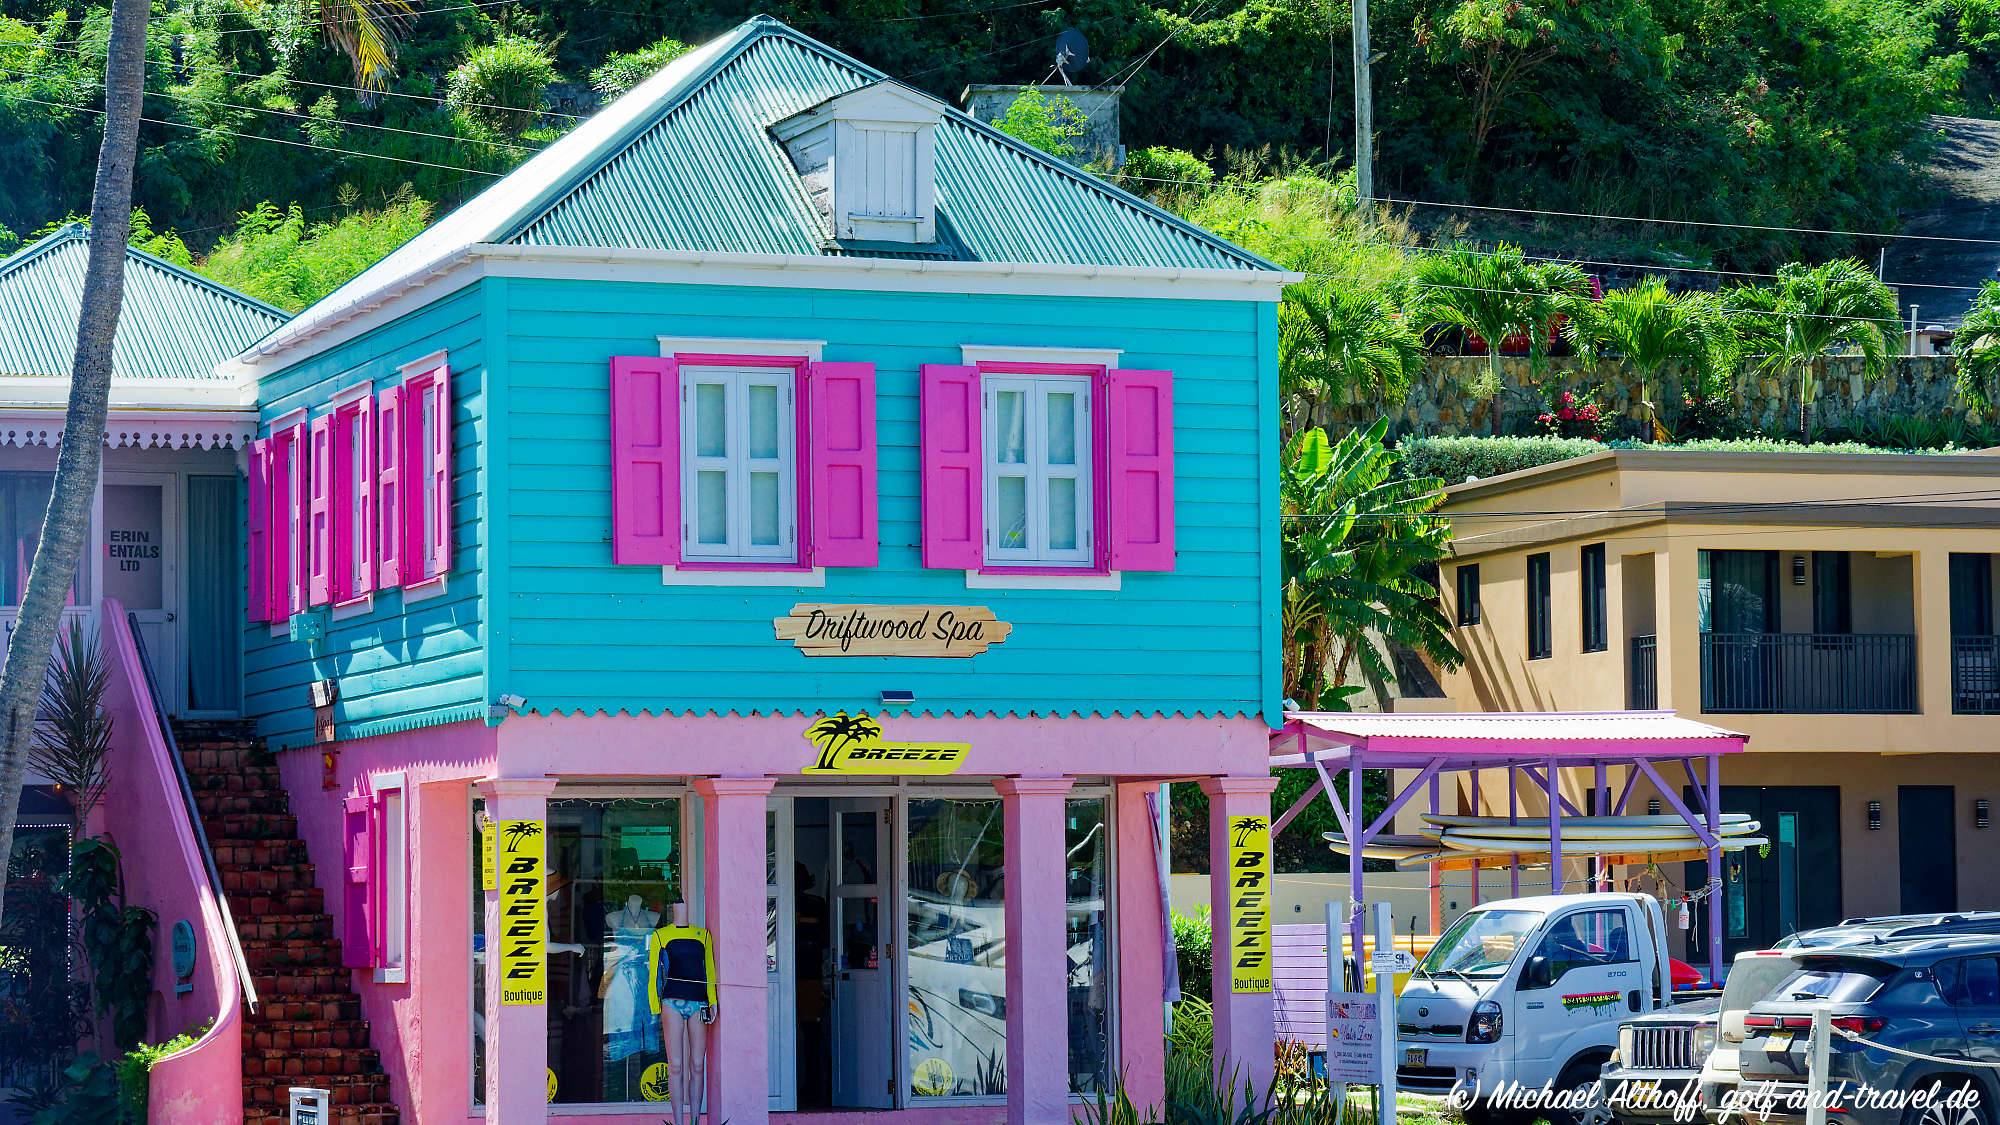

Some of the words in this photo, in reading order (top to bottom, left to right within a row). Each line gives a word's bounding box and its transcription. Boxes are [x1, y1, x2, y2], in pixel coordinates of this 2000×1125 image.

[110, 530, 150, 543] ERIN
[103, 544, 160, 558] ENTALS
[120, 559, 140, 572] LTD
[805, 609, 930, 652] Driftwood
[932, 610, 984, 649] Spa
[848, 748, 961, 761] BREEZE
[1235, 851, 1267, 968] BREEZE
[506, 857, 541, 979] BREEZE
[1234, 977, 1270, 991] Boutique
[504, 989, 543, 1003] Boutique
